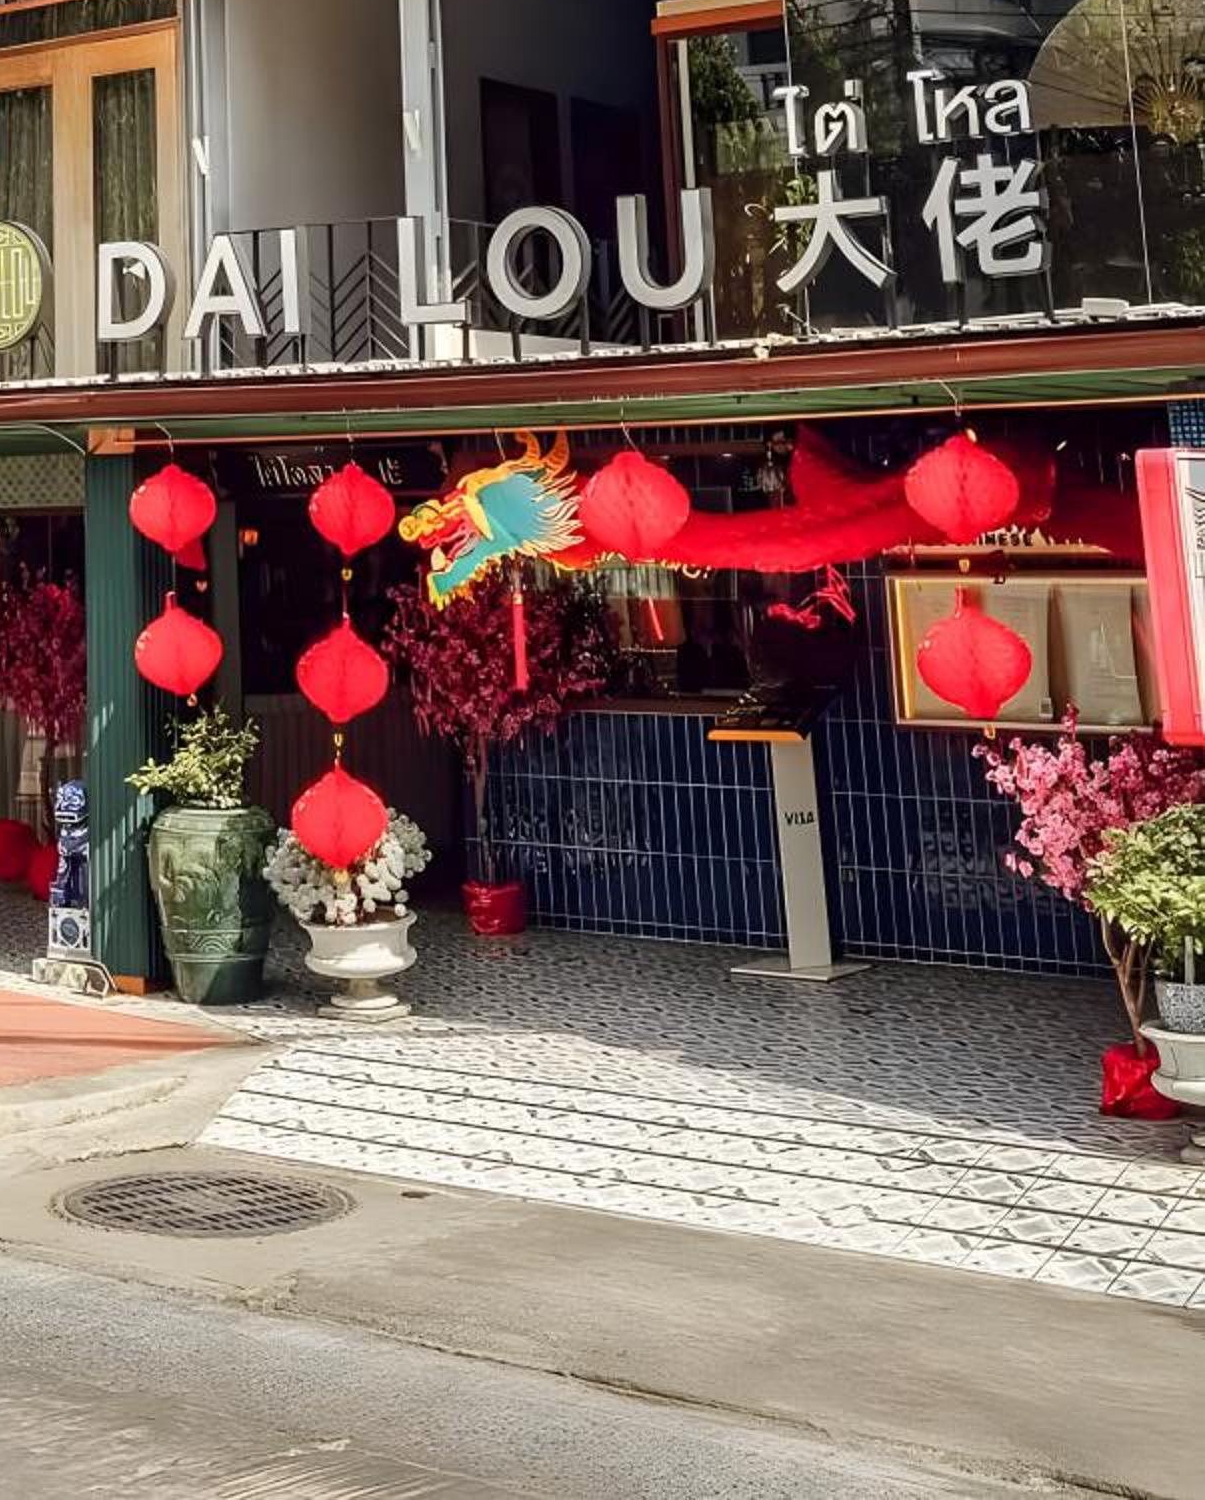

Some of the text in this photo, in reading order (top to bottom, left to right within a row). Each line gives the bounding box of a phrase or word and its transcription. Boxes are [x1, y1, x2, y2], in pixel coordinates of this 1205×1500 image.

[98, 187, 714, 340] DAI LOU
[773, 154, 1045, 293] 大佬
